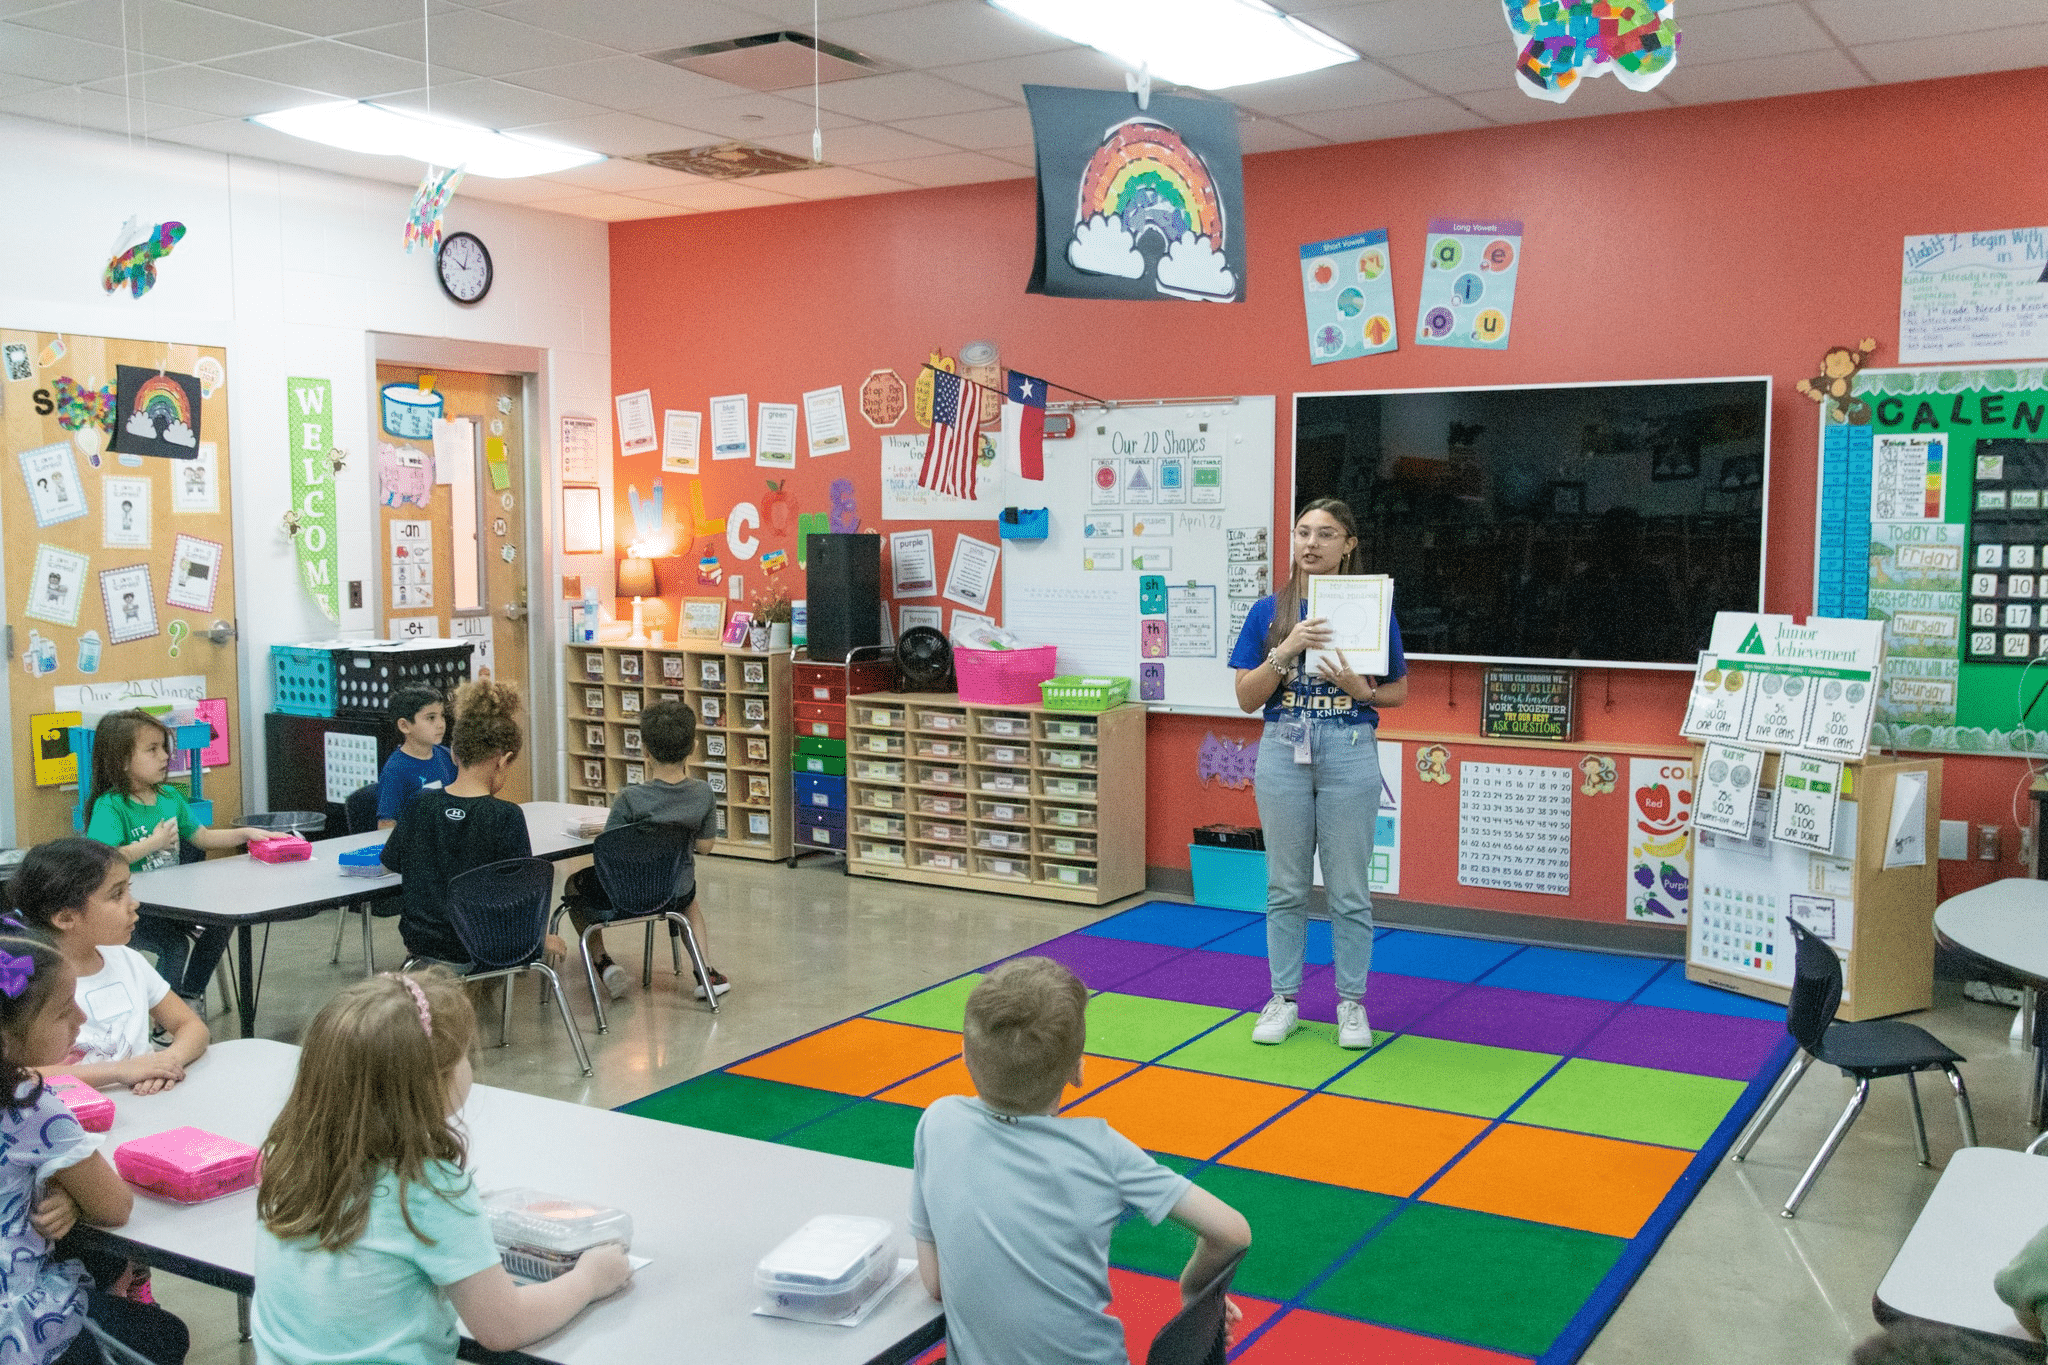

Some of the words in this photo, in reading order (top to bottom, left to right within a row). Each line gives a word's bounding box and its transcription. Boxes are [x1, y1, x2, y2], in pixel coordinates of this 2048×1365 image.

[1453, 224, 1471, 233] Long
[1473, 224, 1498, 232] Vowels
[1440, 246, 1455, 262] a
[1491, 248, 1506, 264] e
[1433, 315, 1446, 329] o
[1484, 317, 1497, 333] u
[33, 388, 54, 415] S
[768, 411, 788, 419] green
[890, 436, 910, 448] How
[1112, 431, 1138, 455] Our
[1143, 431, 1159, 454] 2D
[1163, 429, 1206, 459] Shapes
[1980, 493, 2003, 505] Sun.
[1179, 512, 1206, 532] April
[400, 523, 420, 537] -an
[900, 539, 923, 549] purple
[1985, 550, 1994, 563] 2
[2017, 550, 2026, 563] 3
[1146, 579, 1159, 590] sh
[1980, 577, 1988, 592] 9
[2014, 579, 2030, 593] 10
[909, 615, 932, 624] brown
[1976, 607, 1993, 622] 16
[2011, 609, 2027, 623] 17
[404, 621, 424, 636] -et
[1148, 624, 1160, 634] th
[1774, 622, 1818, 641] Junior
[1975, 636, 1991, 651] 23
[2007, 638, 2024, 652] 24
[1771, 641, 1857, 663] Achievement
[1145, 667, 1159, 678] ch
[1499, 673, 1513, 682] THIS
[80, 685, 111, 704] Our
[150, 679, 204, 701] Shapes
[1328, 687, 1340, 695] OF
[1489, 703, 1513, 712] WORK
[1517, 704, 1566, 715] TOGETHER
[1532, 713, 1550, 723] BEST
[1493, 721, 1508, 732] ASK
[1512, 721, 1561, 735] QUESTIONS
[1696, 720, 1711, 729] one
[1715, 721, 1731, 732] cent
[1775, 726, 1795, 739] cents
[1816, 734, 1829, 745] ten
[1832, 736, 1854, 750] cents
[1645, 798, 1663, 809] Red
[131, 825, 148, 838] IT'S
